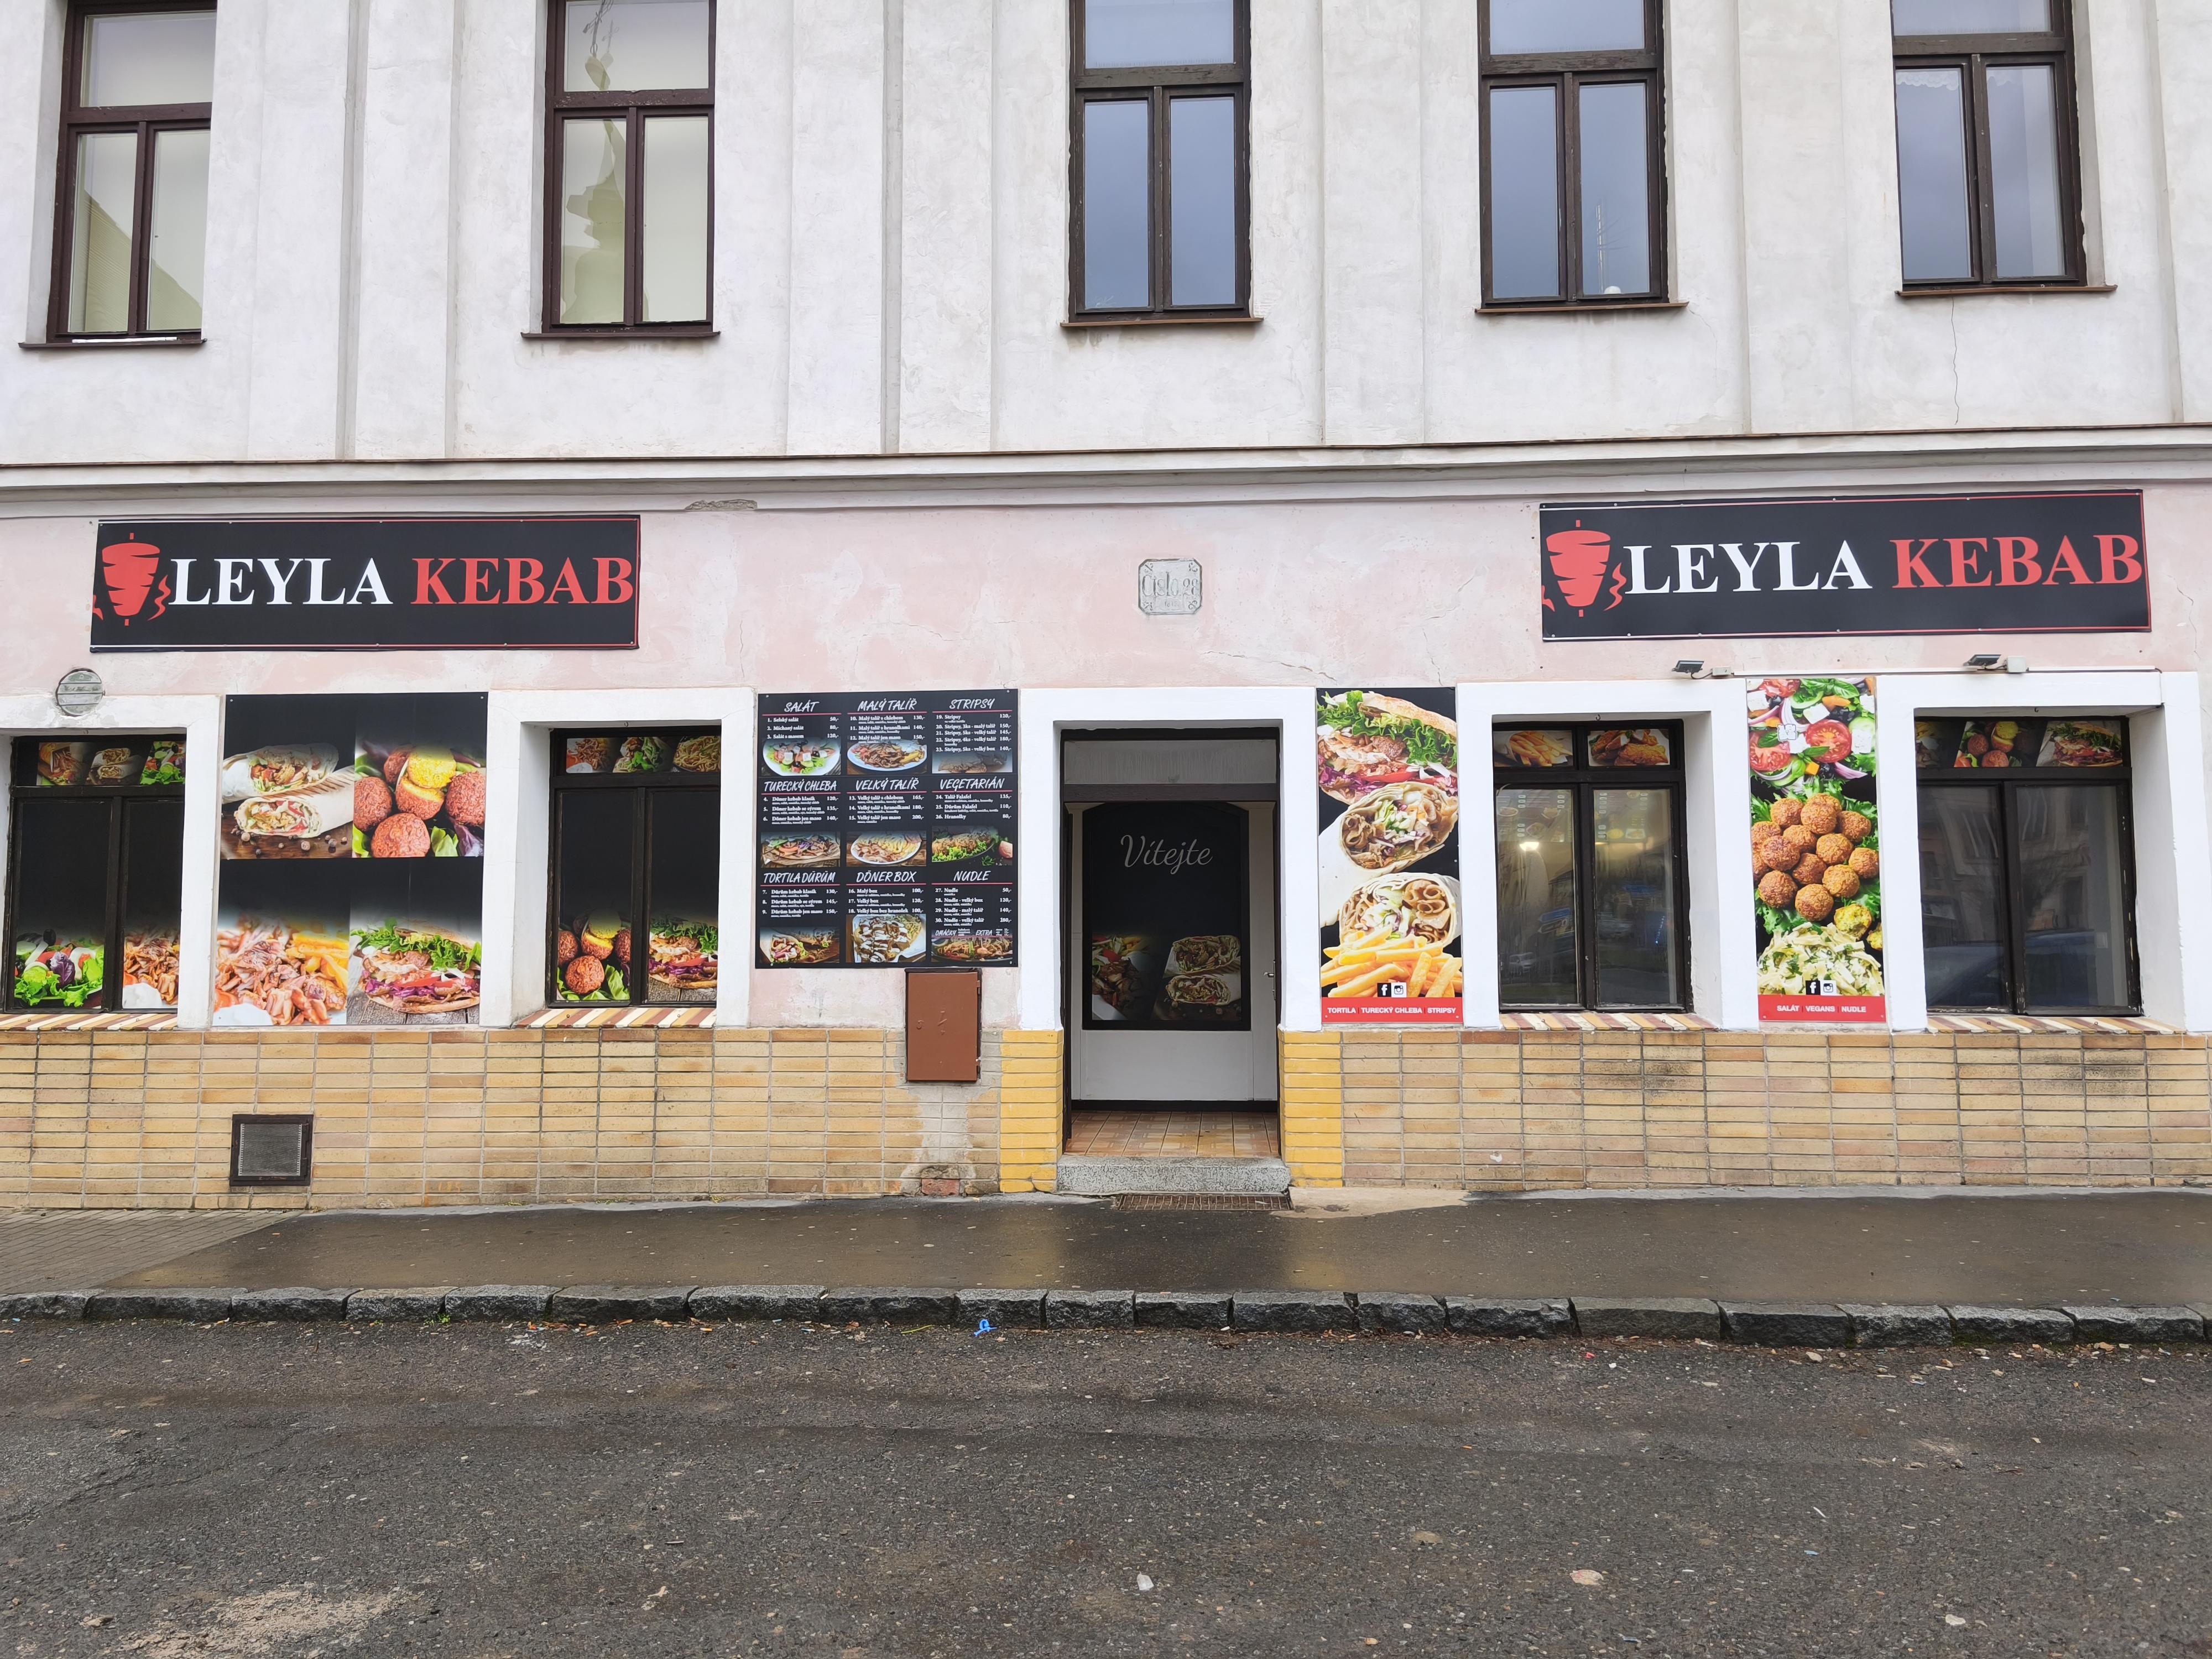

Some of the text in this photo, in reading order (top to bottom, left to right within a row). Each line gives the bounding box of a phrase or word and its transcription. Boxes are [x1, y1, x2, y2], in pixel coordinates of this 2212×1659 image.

[1624, 534, 2143, 594] LEYLA KEBAB
[168, 557, 634, 605] LEYLA KEBAB
[784, 700, 820, 712] SALÁT
[858, 698, 917, 711] MALÝ TALÍŘ
[949, 698, 995, 709] STRIPSY
[764, 779, 837, 791] TURECKÝ CHLEBA
[856, 778, 919, 790] VELKÝ TALÍŘ
[940, 776, 1005, 791] VEGETARIÁN
[1120, 834, 1213, 874] Vítejte
[764, 873, 800, 883] TORTILA
[894, 871, 916, 882] BOX
[953, 870, 991, 881] NUDLE
